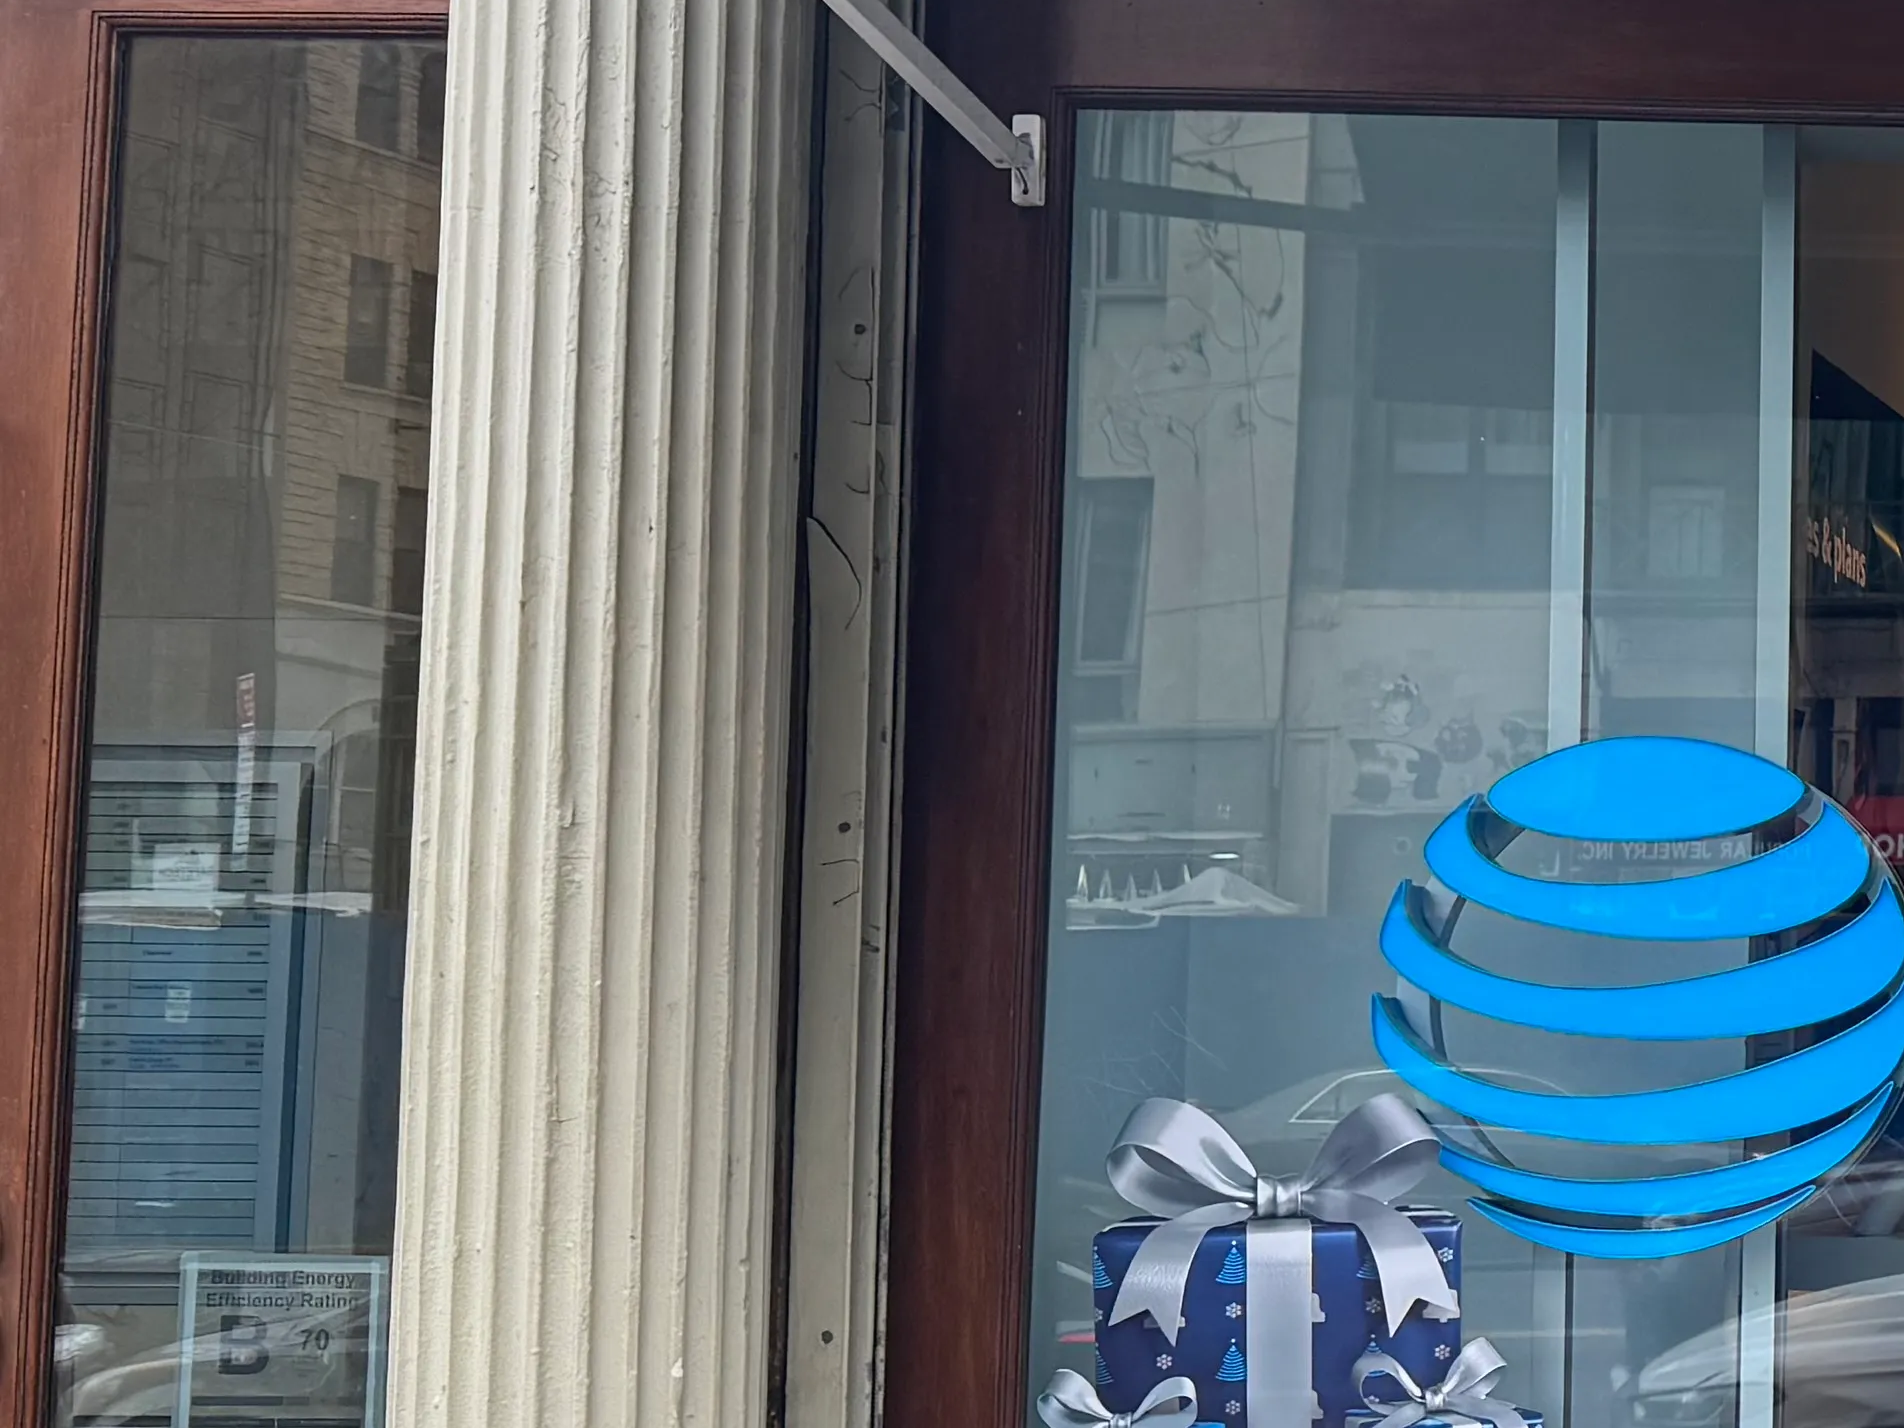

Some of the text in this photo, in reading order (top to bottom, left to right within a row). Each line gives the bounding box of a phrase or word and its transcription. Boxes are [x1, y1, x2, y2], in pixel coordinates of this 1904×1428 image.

[211, 1270, 356, 1289] Building Energy
[206, 1292, 360, 1311] Efficiency Rating
[218, 1314, 270, 1375] B
[299, 1328, 330, 1351] 70
